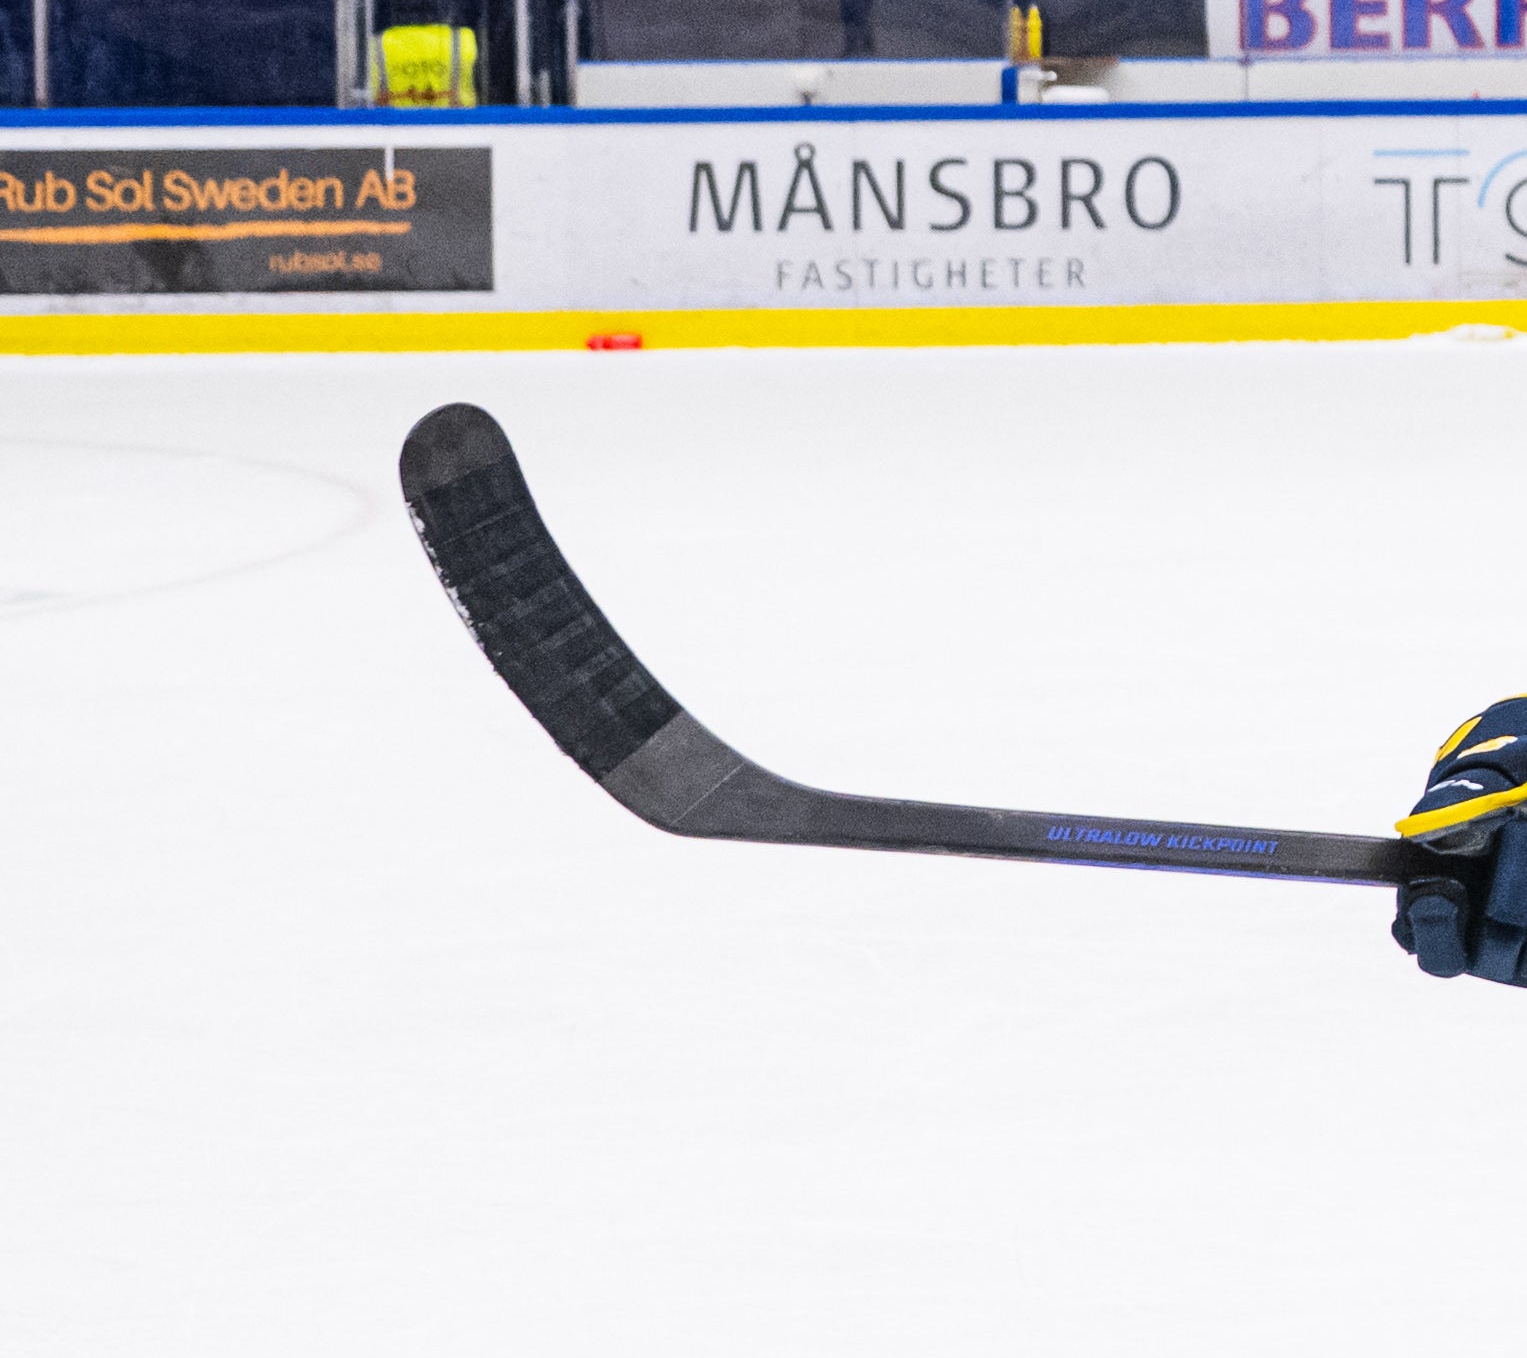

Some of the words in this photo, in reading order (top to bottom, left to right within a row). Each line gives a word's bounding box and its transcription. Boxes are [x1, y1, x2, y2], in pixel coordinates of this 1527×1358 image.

[85, 169, 155, 213] Sol
[162, 168, 344, 212] Sweden
[356, 169, 417, 210] AB
[689, 141, 1183, 233] MÅNSBRO
[775, 257, 1086, 291] FASTIGHETER
[1047, 824, 1162, 849] ULTRALOW
[1166, 834, 1279, 856] KICKPOINT
